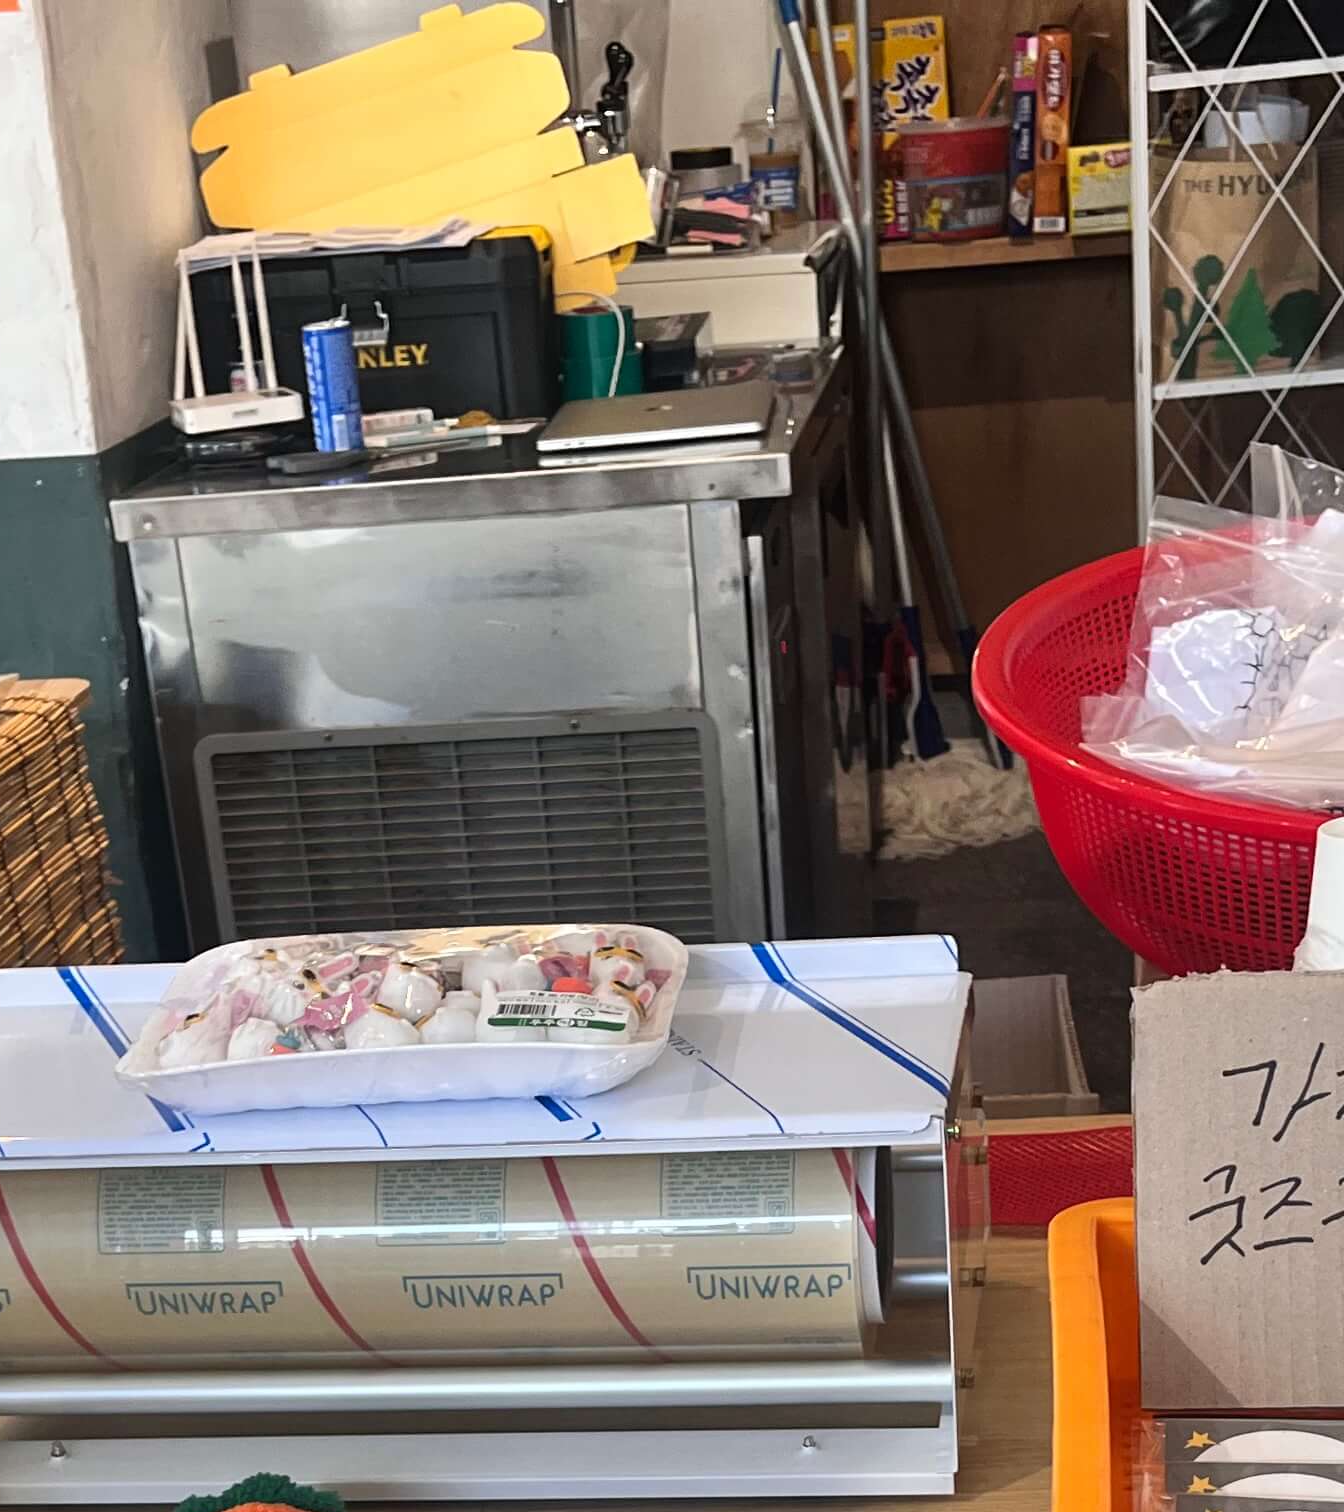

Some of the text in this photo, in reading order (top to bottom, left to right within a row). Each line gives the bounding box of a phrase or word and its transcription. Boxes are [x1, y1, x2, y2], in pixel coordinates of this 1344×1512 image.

[1184, 179, 1213, 193] THE
[357, 343, 429, 369] NLEY
[410, 1282, 557, 1310] UNIWRAP
[695, 1273, 844, 1301] UNIWRAP
[135, 1288, 278, 1316] UNIWRAP
